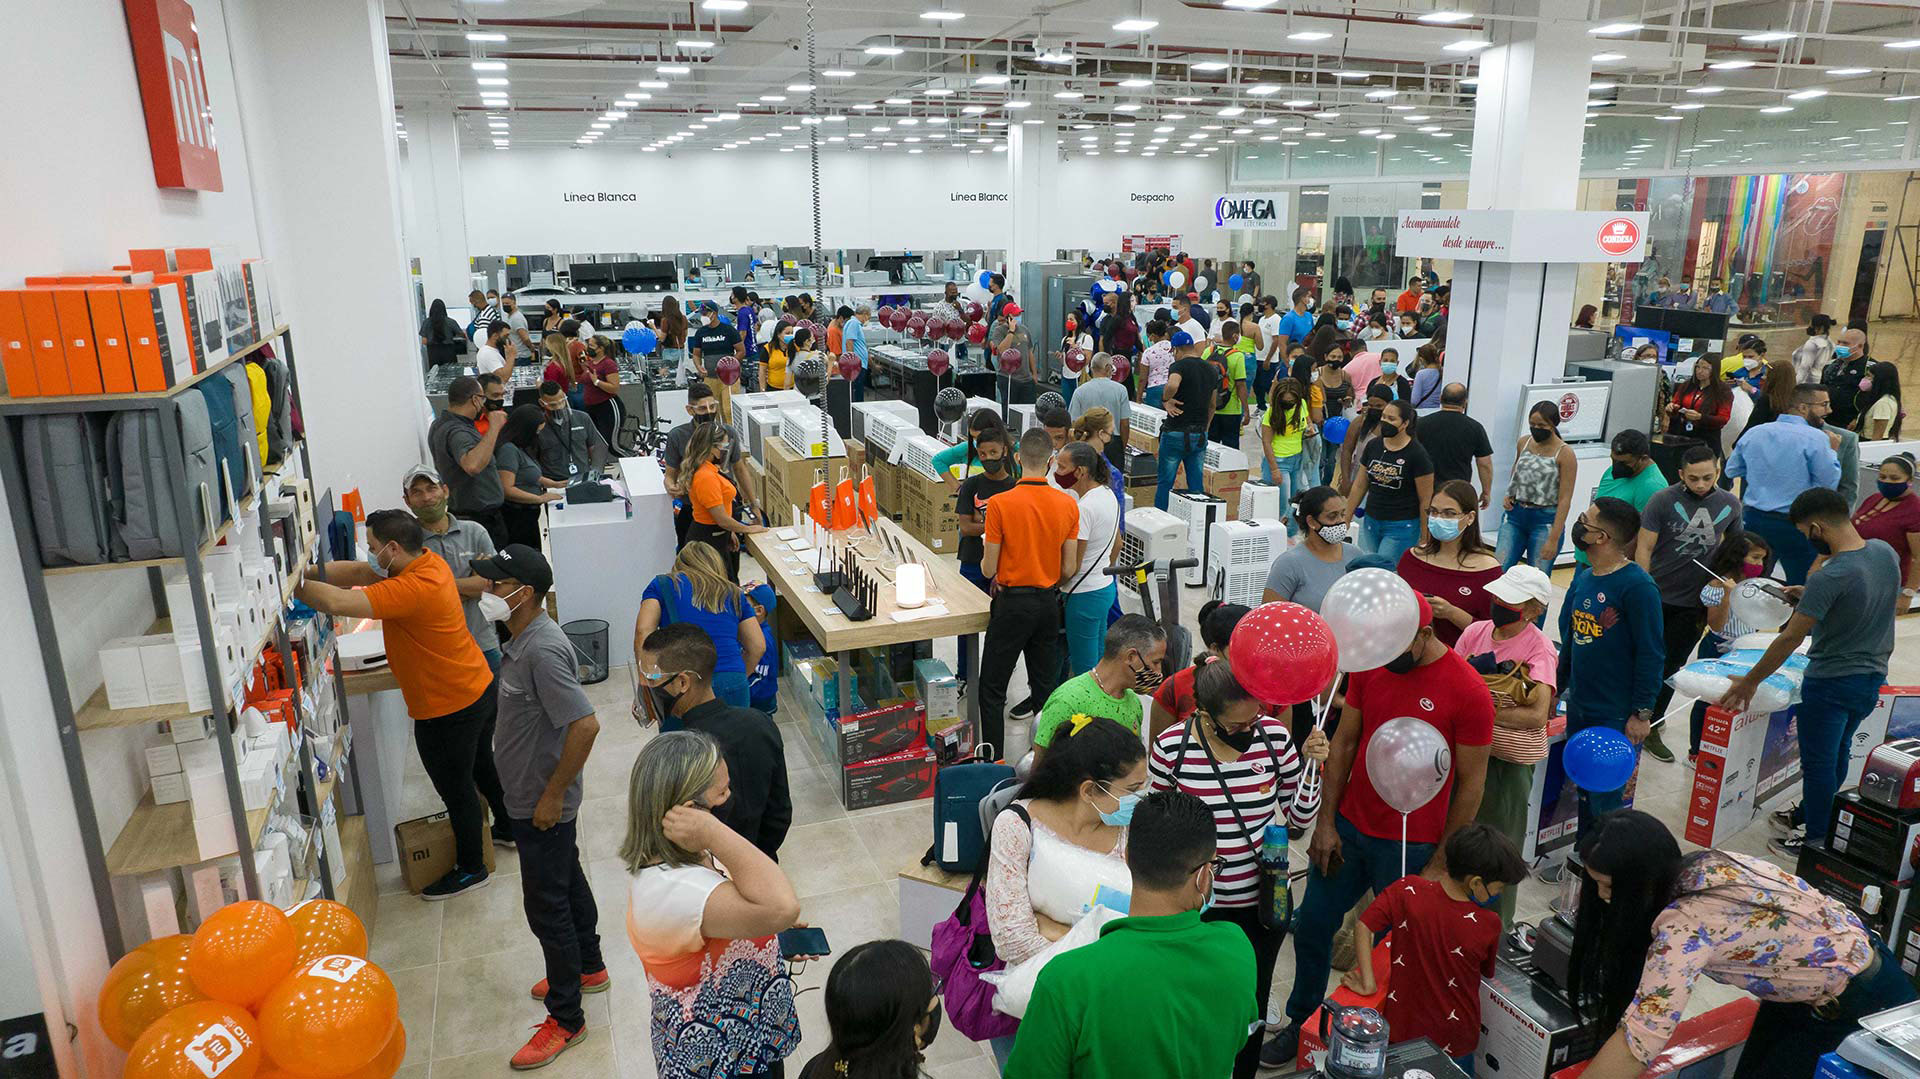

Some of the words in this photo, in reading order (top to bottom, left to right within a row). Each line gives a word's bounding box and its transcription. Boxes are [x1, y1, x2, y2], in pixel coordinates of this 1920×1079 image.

[563, 191, 595, 202] Línea
[597, 192, 637, 202] Blanca
[950, 191, 977, 201] Línea
[1130, 193, 1175, 203] Despacho
[1221, 199, 1276, 219] OMEGA
[1442, 235, 1463, 248] desde
[1602, 235, 1633, 243] CONDESA
[1702, 743, 1724, 755] NETFLIX
[1489, 991, 1546, 1040] KitchenAid
